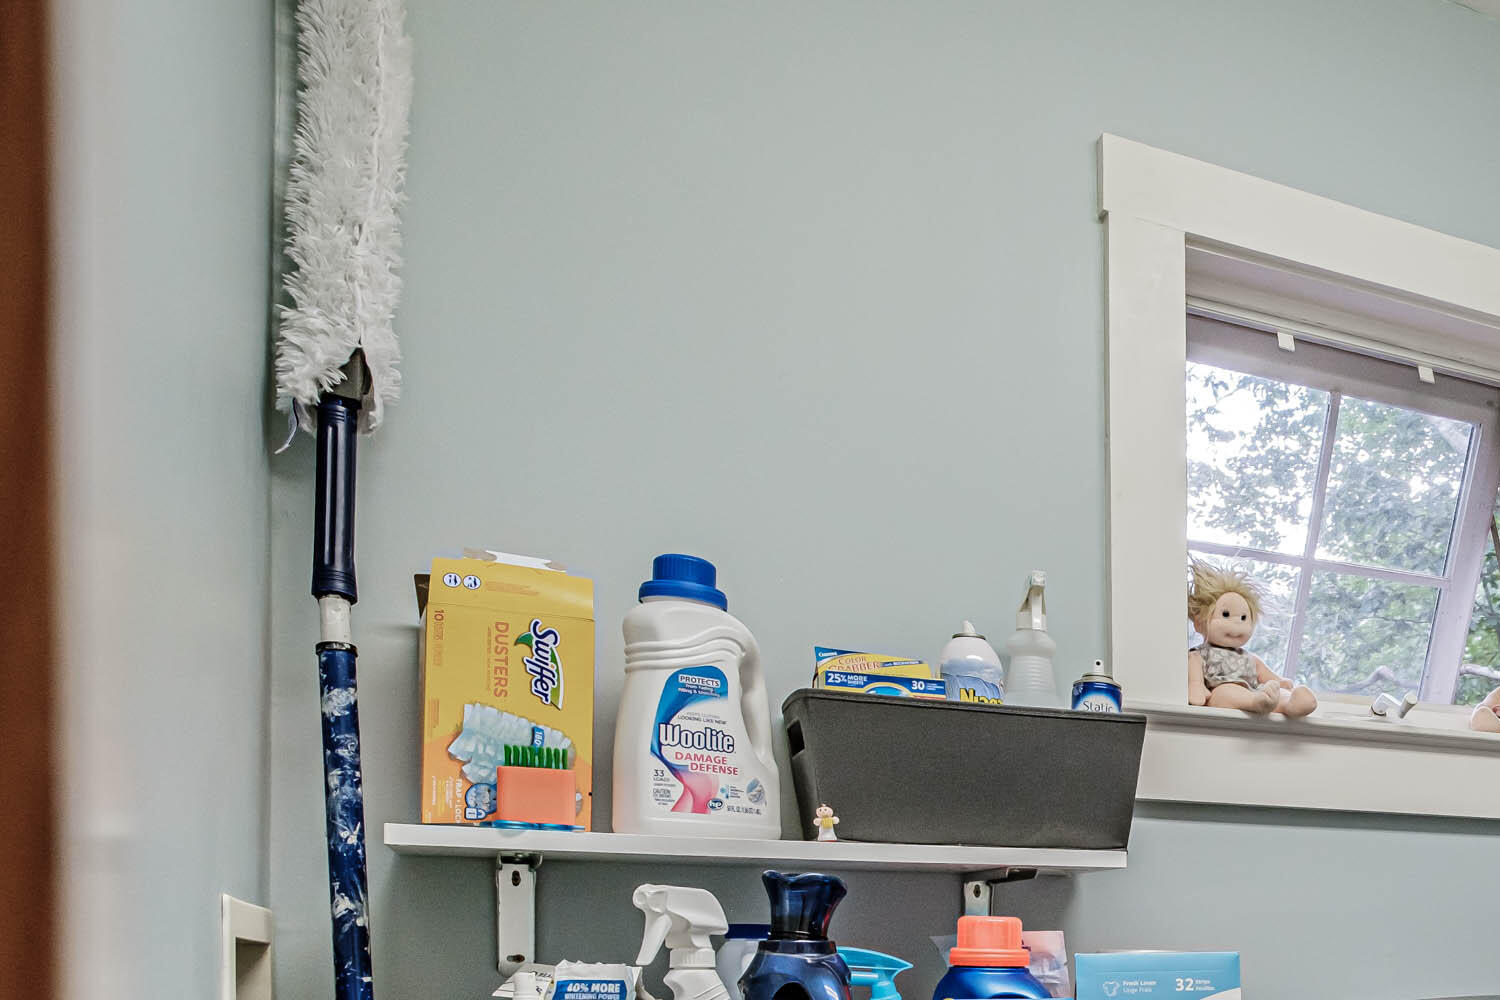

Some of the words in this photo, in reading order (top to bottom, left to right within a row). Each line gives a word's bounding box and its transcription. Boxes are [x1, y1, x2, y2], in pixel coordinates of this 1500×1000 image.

[493, 621, 509, 698] DUSTERS
[524, 619, 560, 704] Swiffer
[679, 675, 720, 687] PROTECTS
[827, 673, 847, 683] 25%
[911, 680, 925, 690] 30
[658, 723, 735, 753] Woolite
[675, 752, 728, 765] DAMAGE
[690, 762, 738, 776] DEFENSE
[566, 983, 589, 992] 40%
[590, 982, 621, 993] MORE
[1175, 978, 1194, 992] 32
